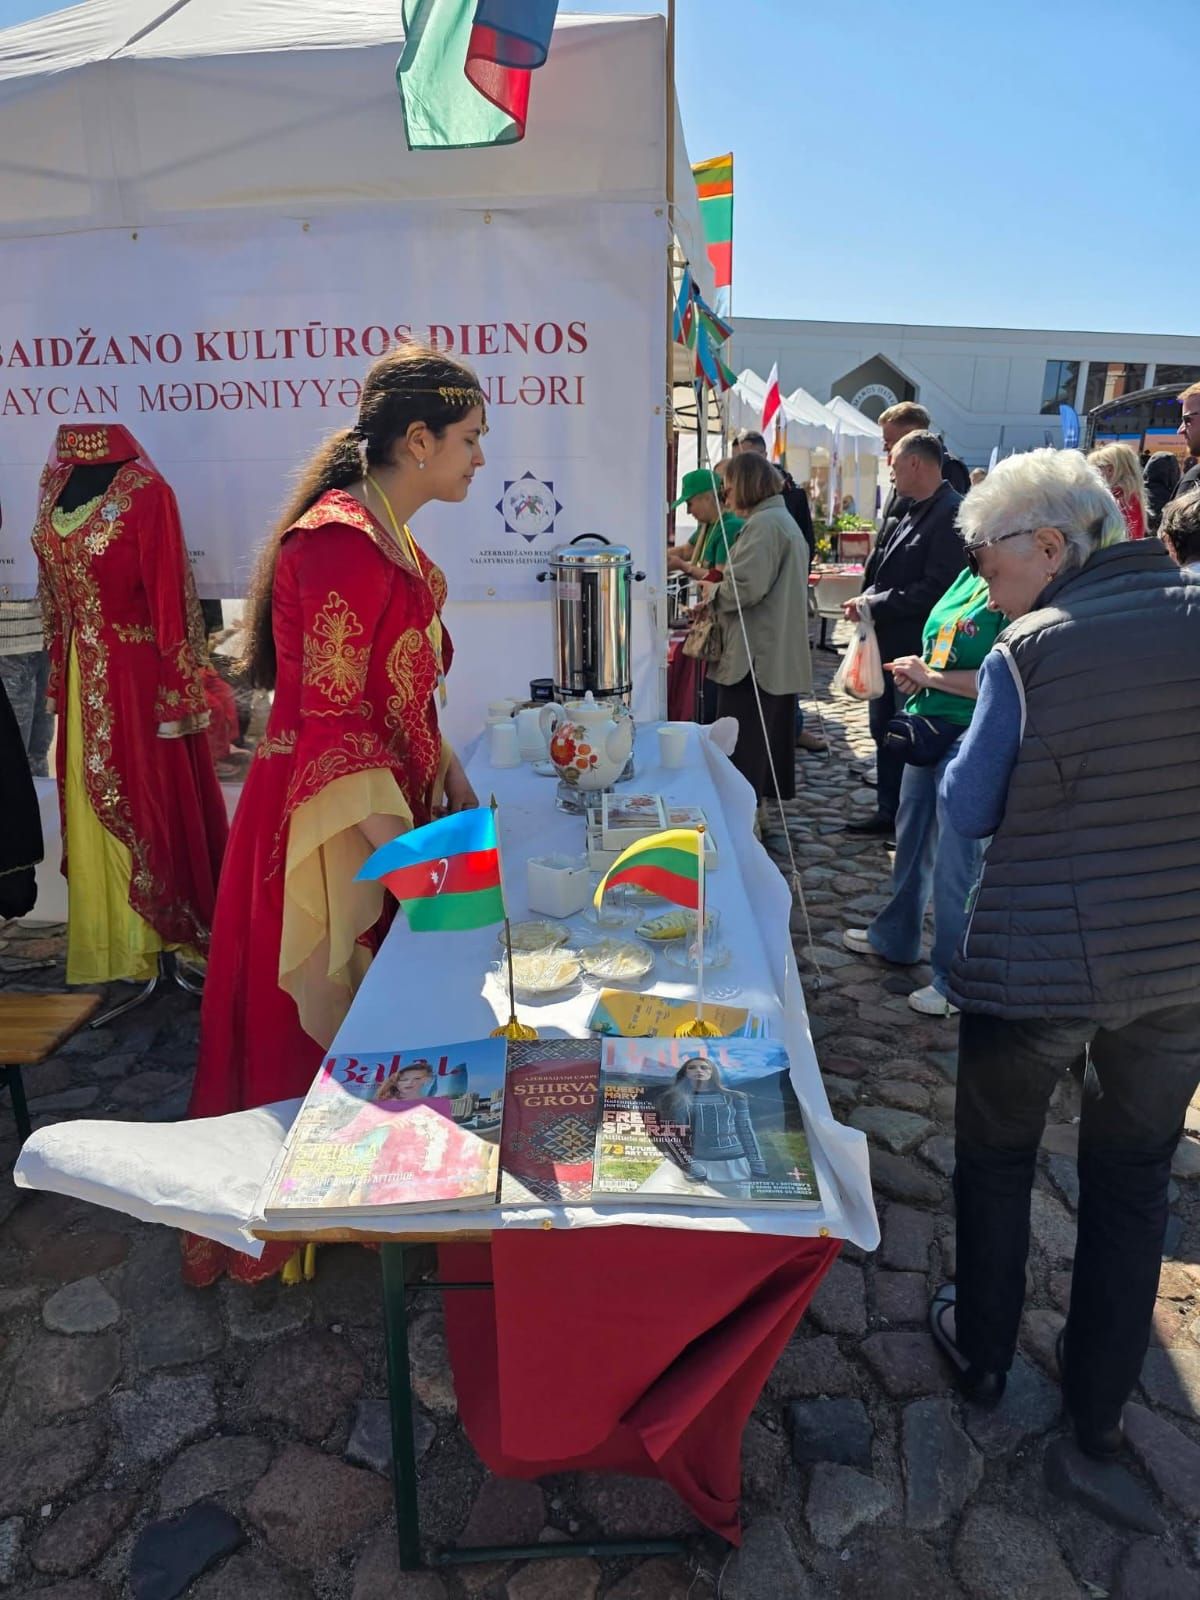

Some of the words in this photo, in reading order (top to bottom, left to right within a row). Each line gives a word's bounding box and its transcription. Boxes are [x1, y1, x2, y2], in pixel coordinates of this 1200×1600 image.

[0, 328, 182, 367] AIDŽANO
[194, 322, 412, 361] KULTŪROS
[427, 321, 588, 355] DIENOS
[1, 385, 119, 415] AYCAN
[138, 378, 363, 413] MƏDƏNIYYƏ
[480, 376, 585, 405] NLƏRI
[513, 1082, 598, 1095] SHIRVA
[524, 1094, 595, 1107] GROU
[604, 1092, 638, 1100] MARY
[602, 1111, 657, 1124] FREE
[602, 1122, 689, 1137] SPIRIT
[602, 1143, 624, 1156] 73
